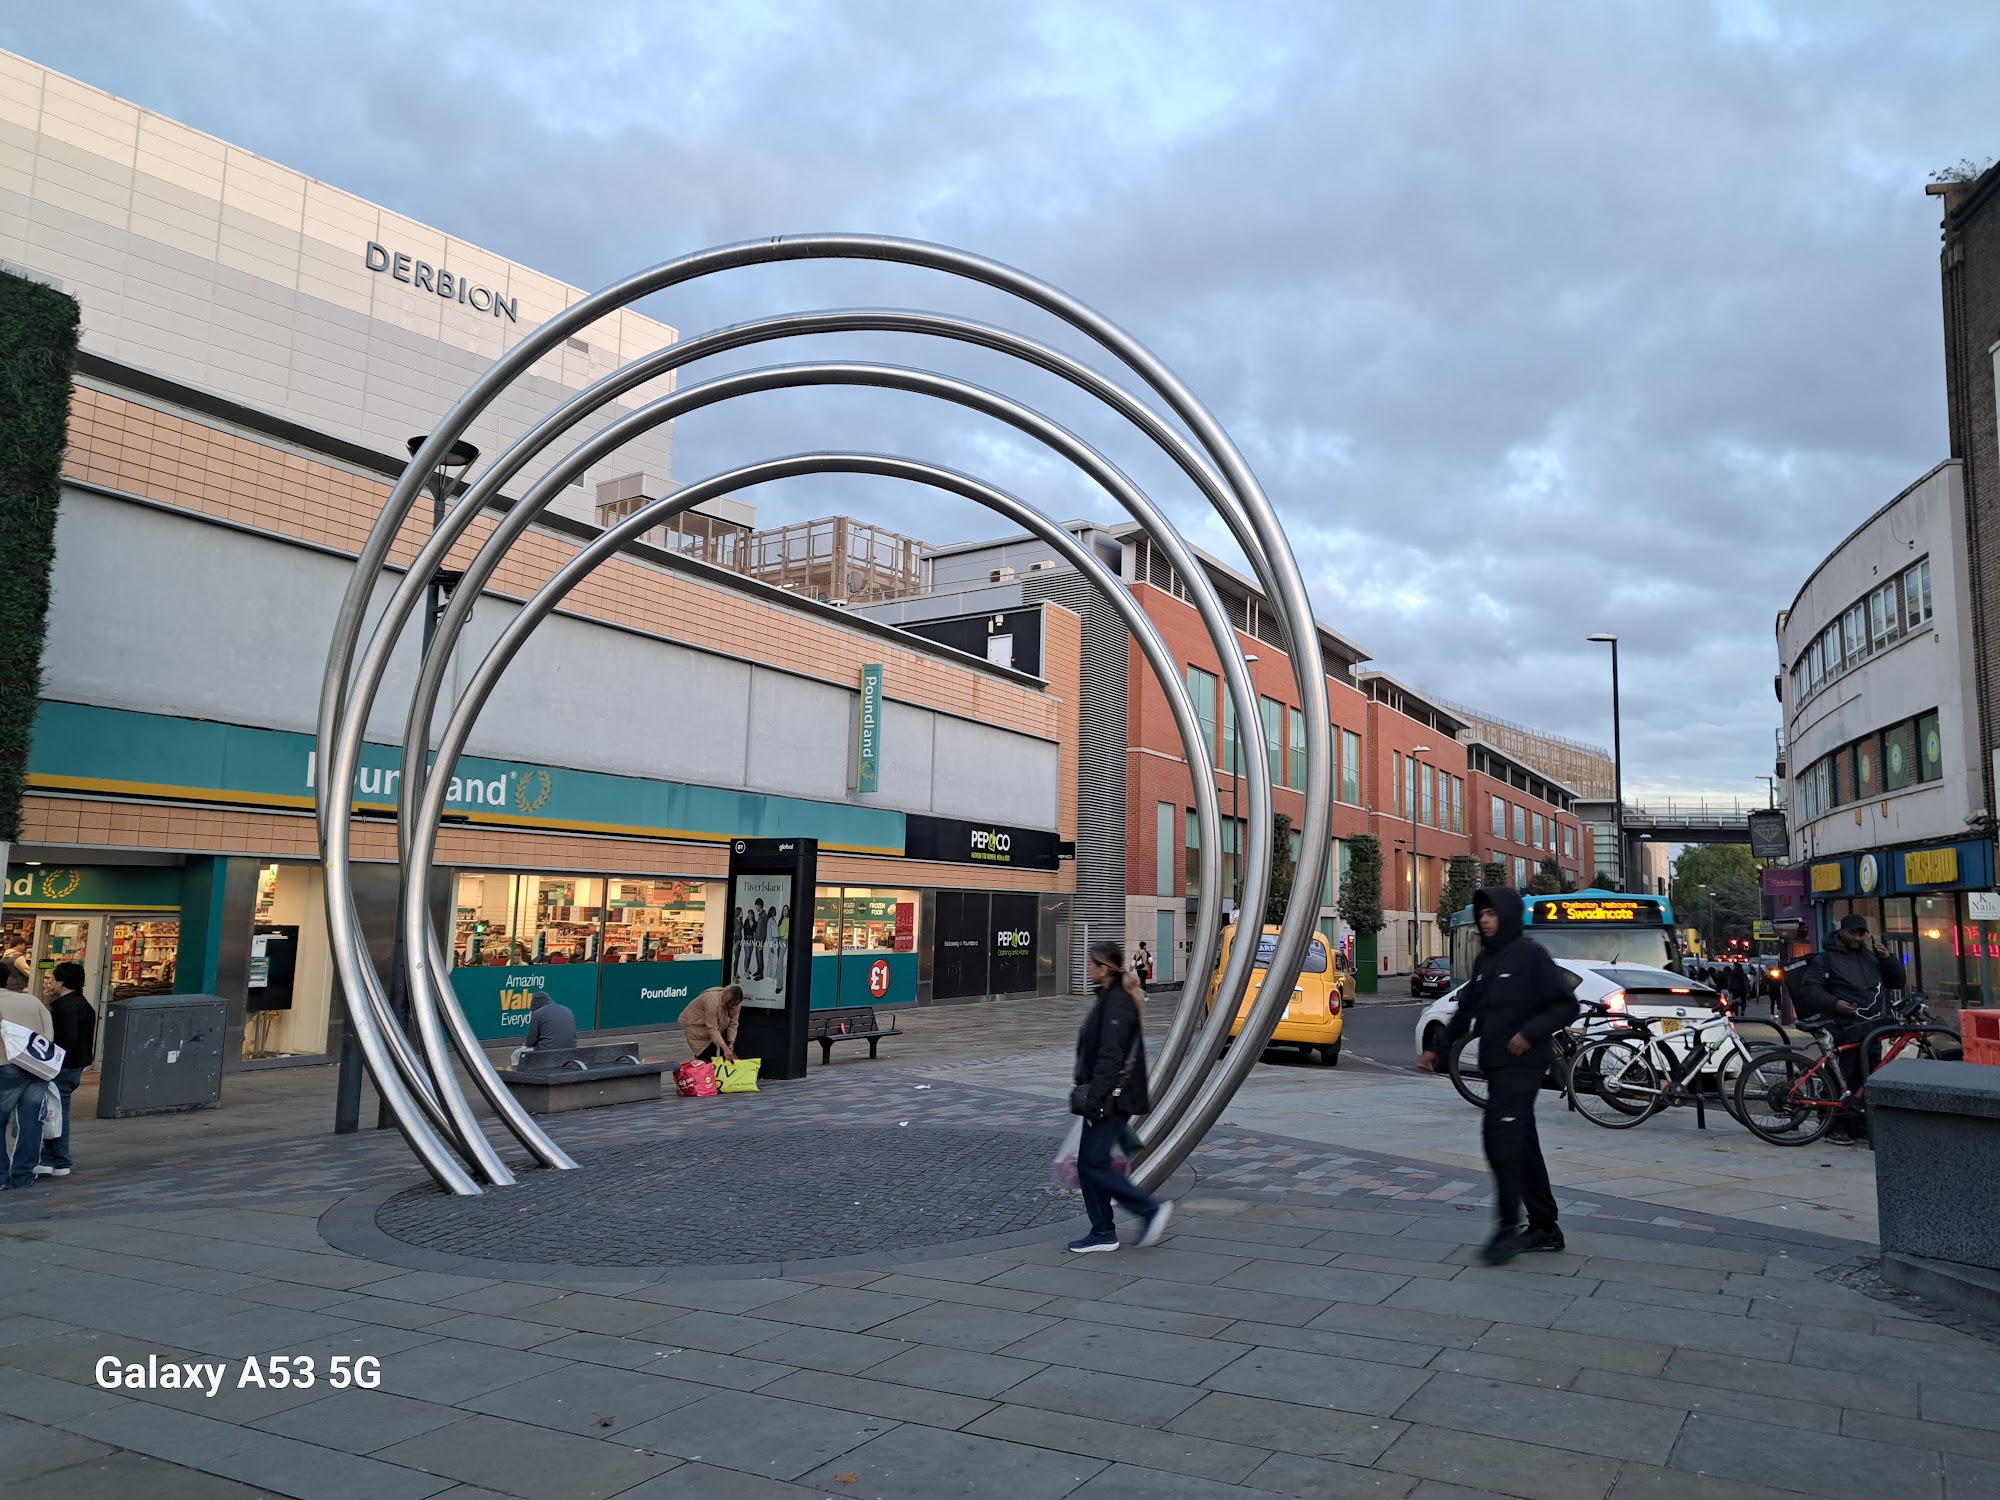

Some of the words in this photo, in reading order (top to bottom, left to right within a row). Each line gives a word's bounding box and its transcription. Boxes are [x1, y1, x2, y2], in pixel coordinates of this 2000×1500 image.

[366, 241, 517, 323] DERBION
[862, 676, 877, 758] Poundland
[306, 752, 507, 806] unand
[779, 844, 794, 852] global
[1972, 901, 1996, 911] Nails
[1980, 893, 1987, 903] K
[1545, 902, 1557, 920] 2
[505, 973, 545, 989] Amazing
[870, 966, 888, 990] £1
[500, 989, 532, 1011] Val
[641, 986, 688, 999] Poundland
[501, 1012, 532, 1027] Everyd
